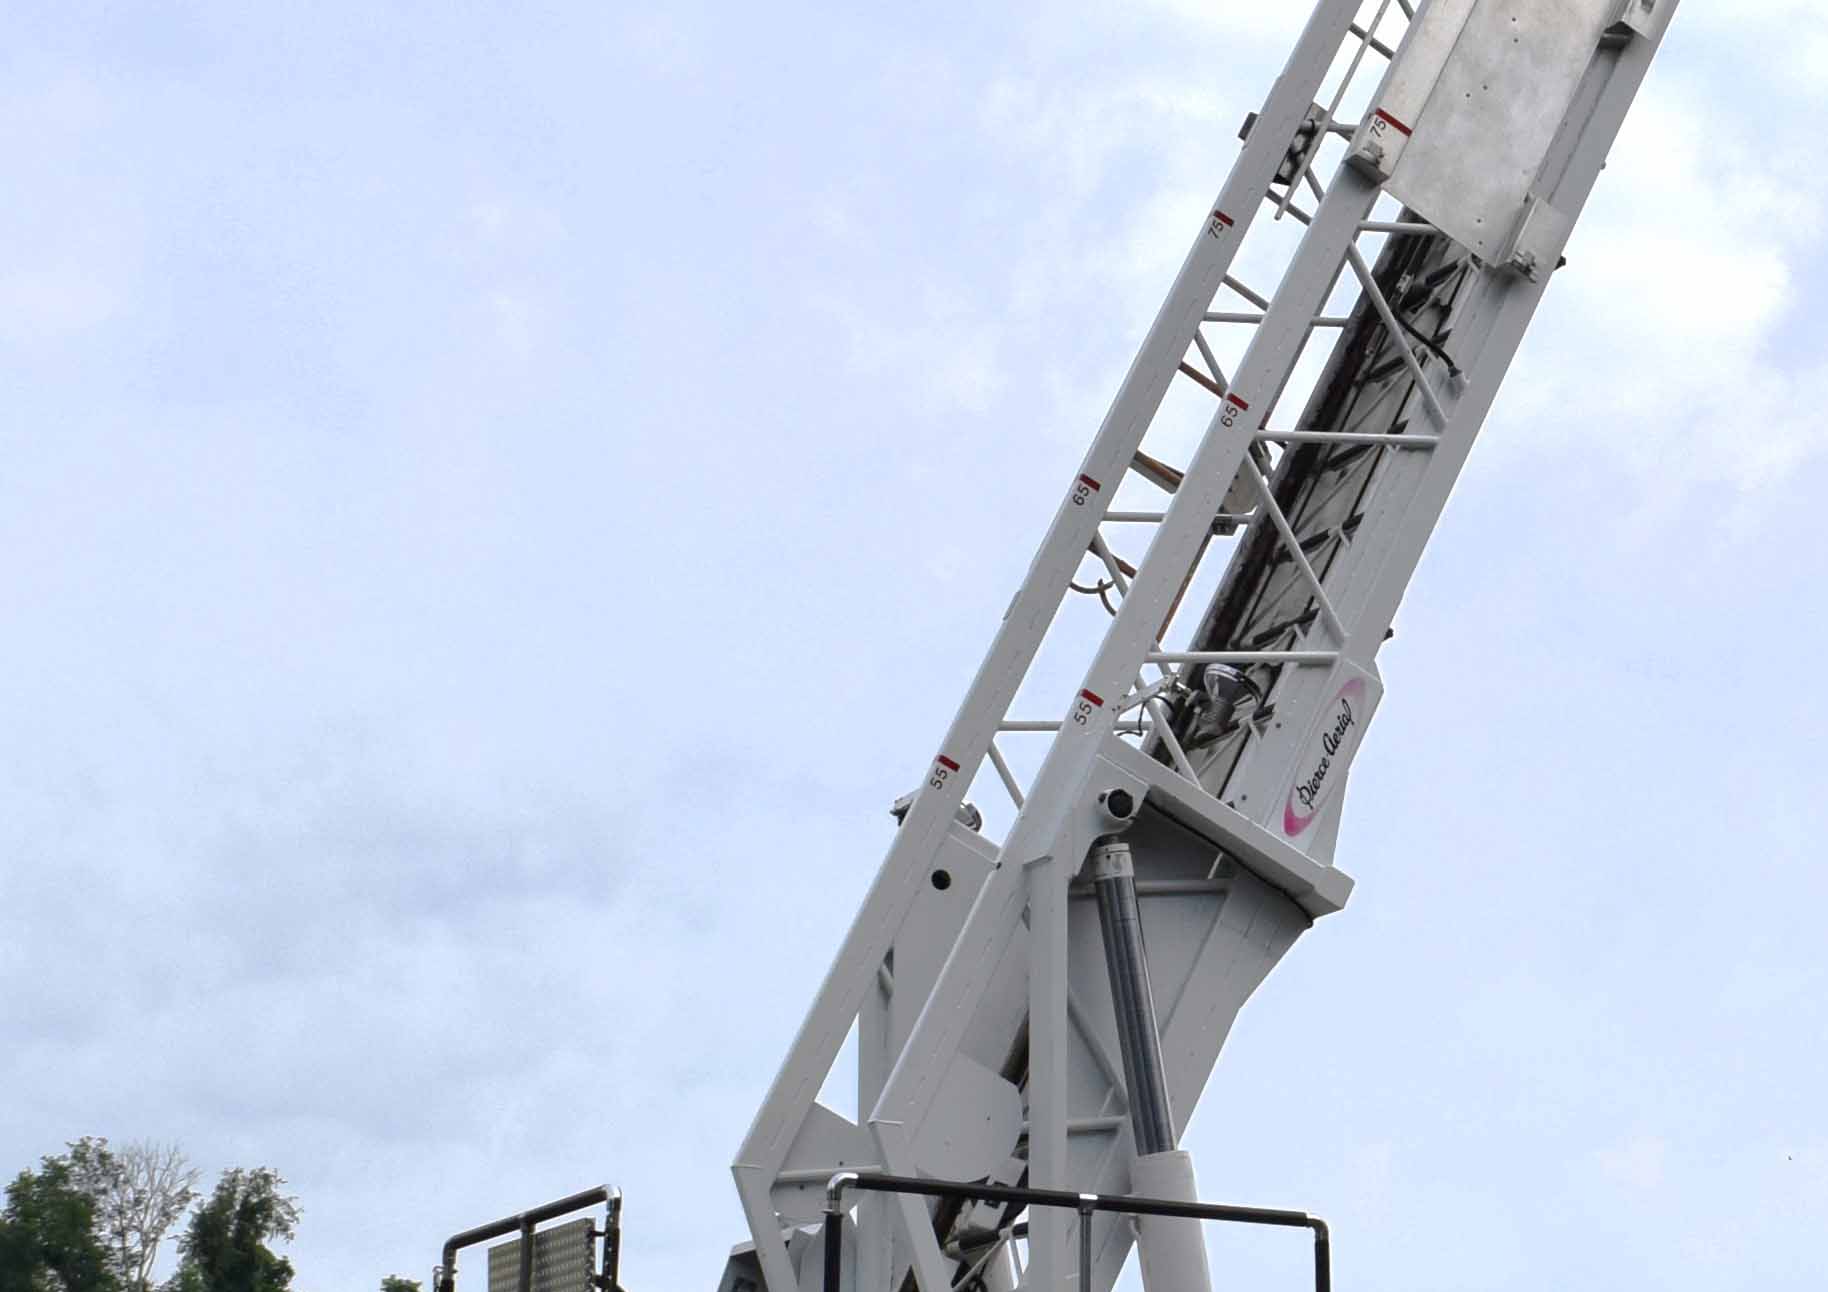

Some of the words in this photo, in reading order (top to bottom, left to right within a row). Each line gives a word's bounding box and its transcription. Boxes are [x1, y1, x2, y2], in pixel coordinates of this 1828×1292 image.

[1369, 118, 1386, 138] 75
[1208, 219, 1225, 239] 75
[1220, 404, 1238, 428] 65
[1072, 483, 1090, 507] 65
[1074, 701, 1093, 726] 55
[930, 767, 948, 790] 55
[1296, 756, 1330, 810] Pierce
